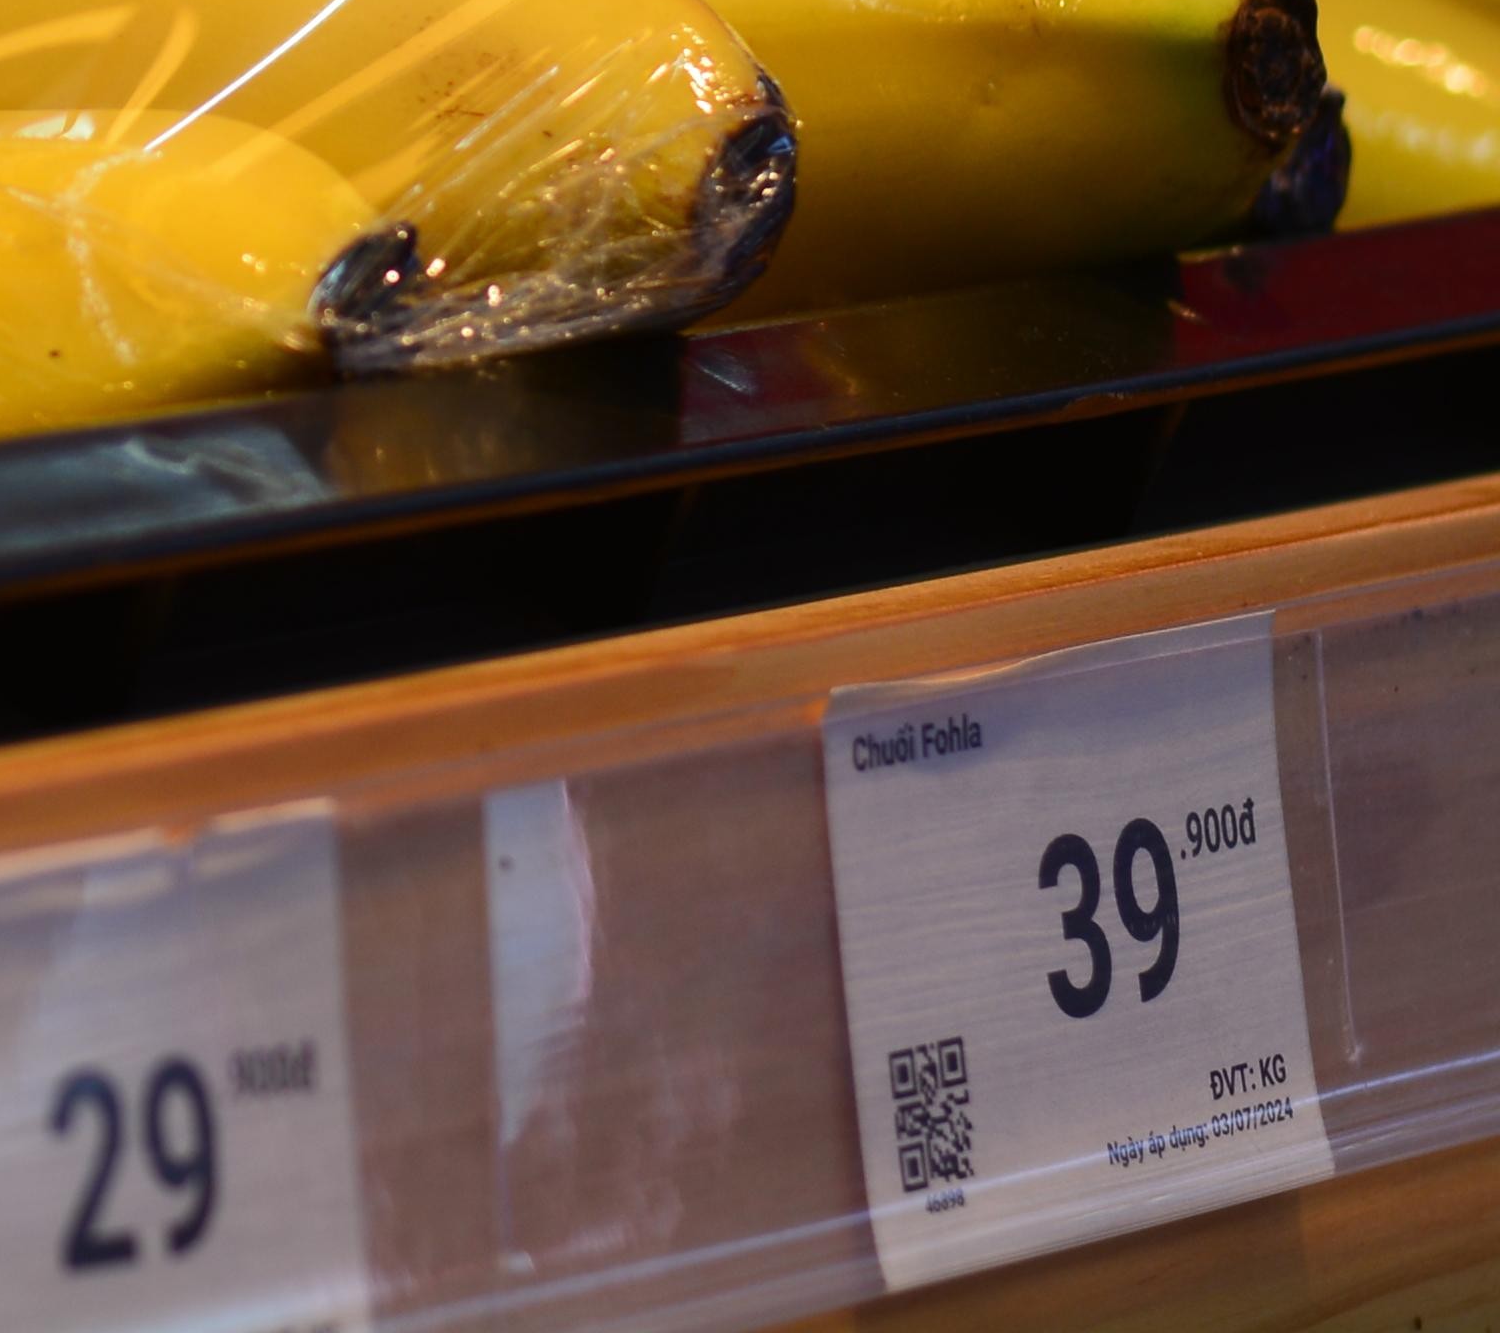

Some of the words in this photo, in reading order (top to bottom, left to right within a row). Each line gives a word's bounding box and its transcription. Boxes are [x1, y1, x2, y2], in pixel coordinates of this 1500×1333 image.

[921, 713, 983, 758] Fohla
[1037, 817, 1180, 1019] 39
[1209, 1062, 1257, 1101] ĐVT:
[1259, 1053, 1287, 1088] KG
[49, 1051, 220, 1273] 29
[1107, 1136, 1145, 1168] Ngày
[1148, 1131, 1167, 1159] áp
[1169, 1123, 1210, 1152] dụng:
[1211, 1096, 1294, 1138] 03/07/2024
